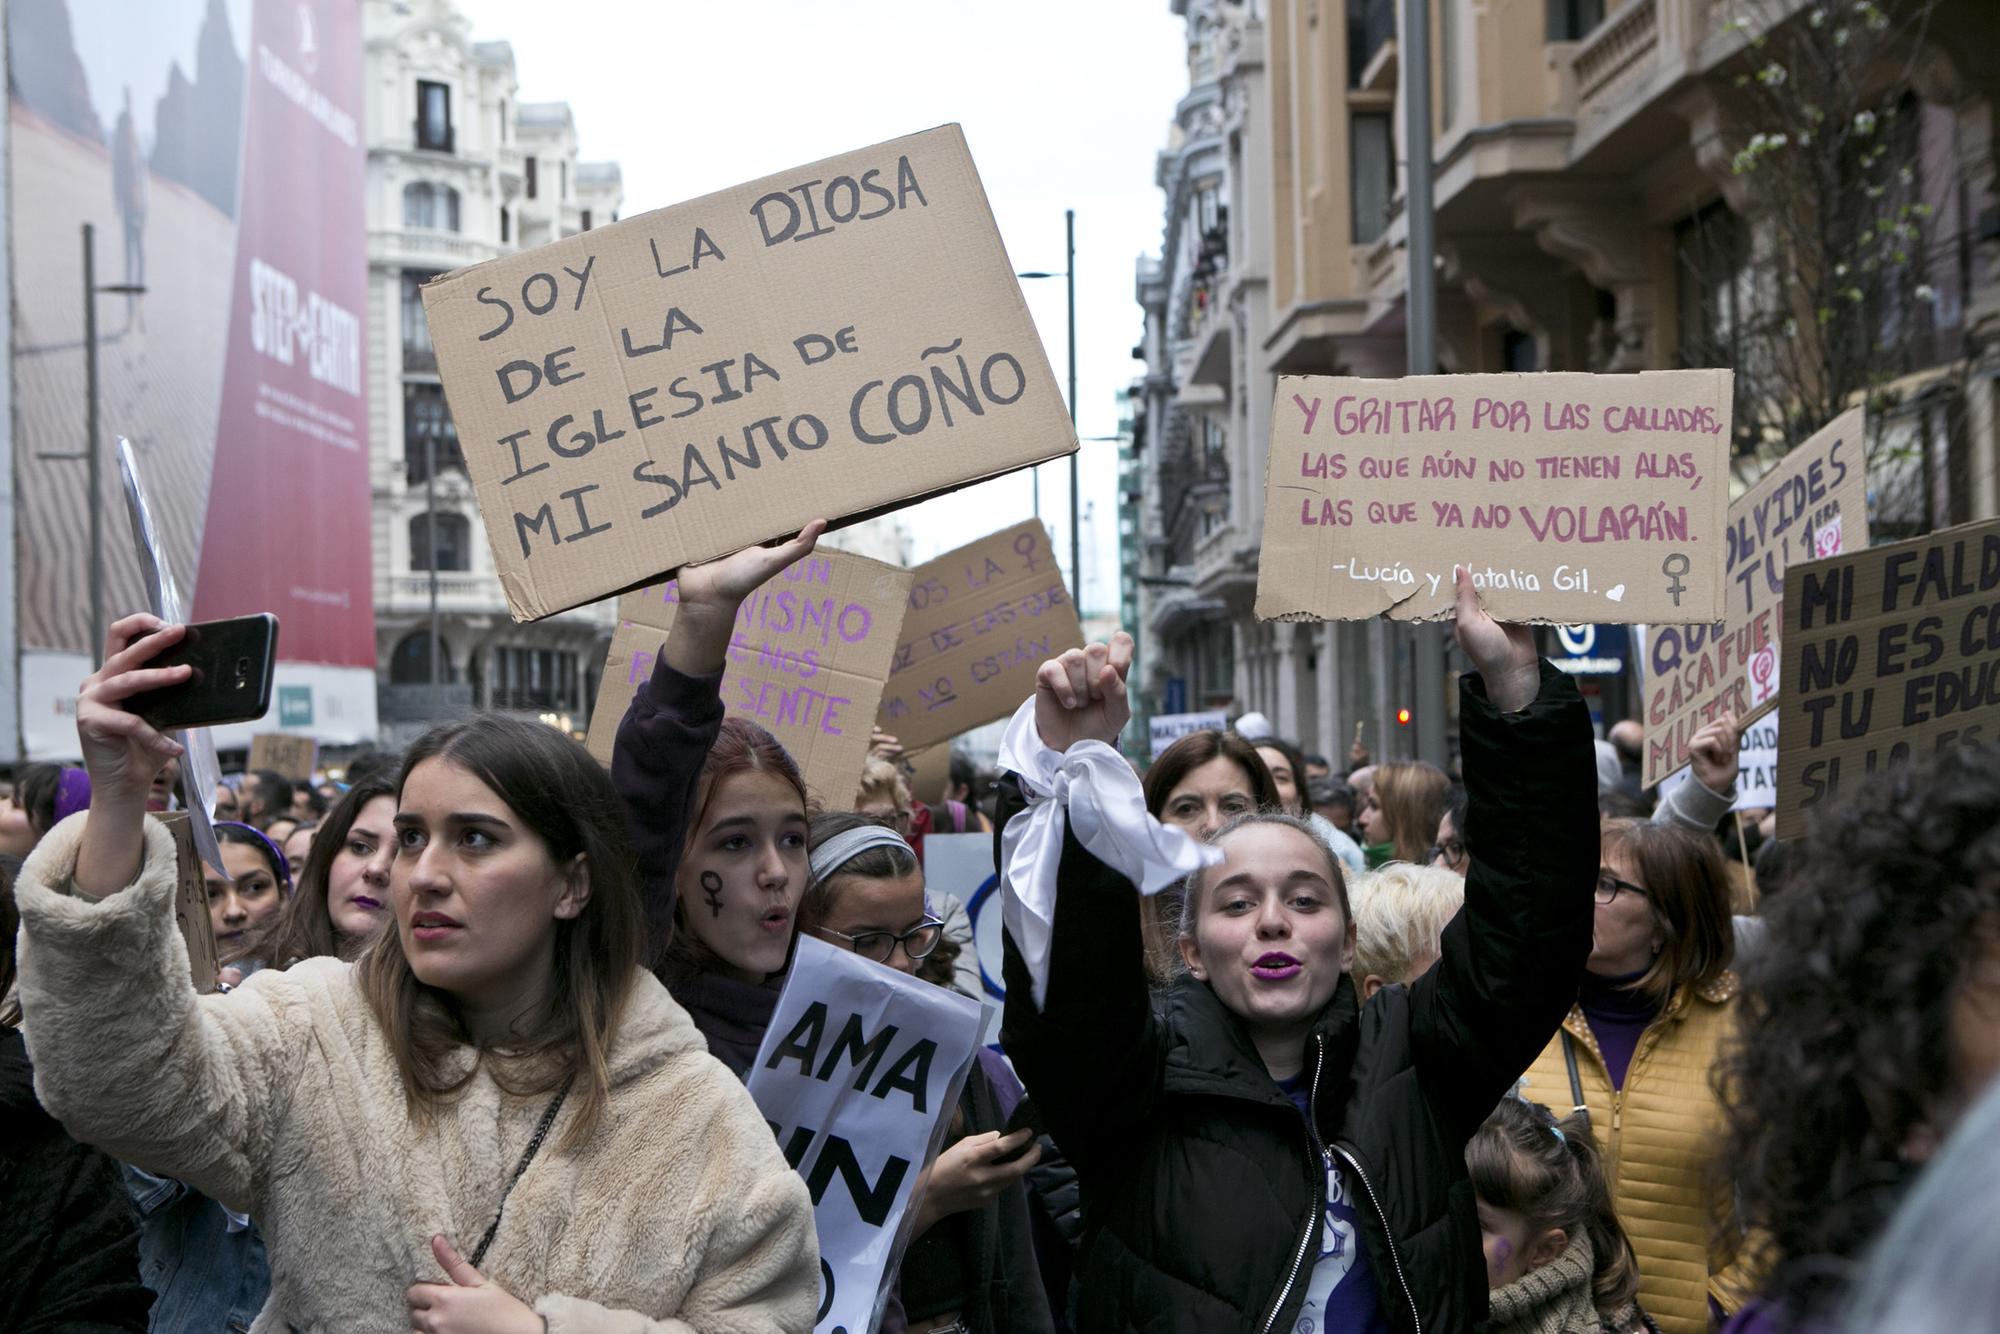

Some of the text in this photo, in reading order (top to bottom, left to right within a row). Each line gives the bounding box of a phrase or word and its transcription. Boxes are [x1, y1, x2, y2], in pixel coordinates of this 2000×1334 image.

[477, 155, 928, 341] SOY LA DIOSA
[496, 306, 704, 404] DE LA
[497, 325, 859, 486] IGLESIA DE
[1293, 393, 1724, 436] Y GRITAR POR LAS CALLADAS,
[513, 337, 1027, 559] MI SANTO COÑO
[1301, 450, 1704, 490] LAS QUE AÚN NO TIENEN ALAS,
[1301, 498, 1699, 542] LAS QUE YA NO VOLARÁN.
[965, 557, 1006, 588] LA
[1425, 570, 1442, 597] y
[1800, 564, 1854, 630] MI
[971, 602, 1017, 636] LAS
[759, 641, 820, 678] NOS
[1650, 652, 1716, 727] CASA
[1718, 609, 1771, 679] FUE
[1800, 634, 1860, 695] NO
[1876, 616, 1945, 678] ES
[1803, 687, 1875, 749] TU
[764, 1000, 939, 1115] AMA
